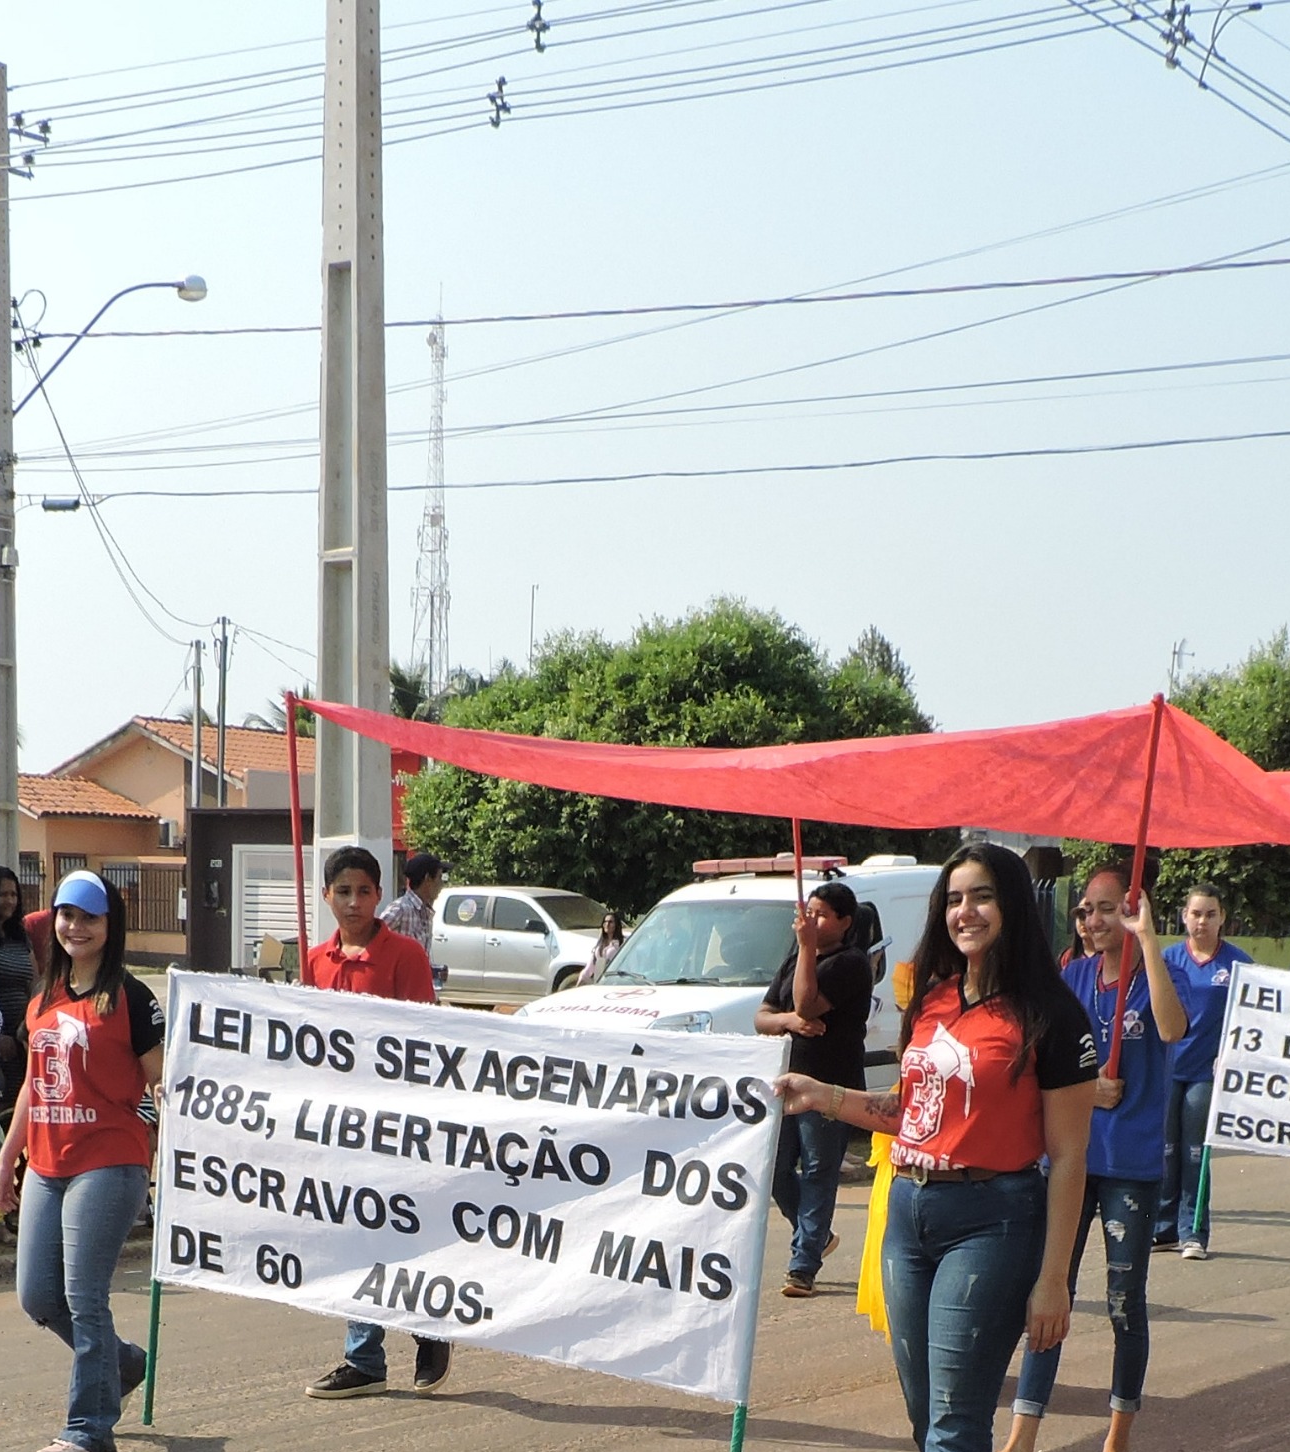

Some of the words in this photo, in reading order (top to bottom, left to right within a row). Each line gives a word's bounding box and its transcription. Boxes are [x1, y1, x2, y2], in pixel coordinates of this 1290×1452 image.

[1238, 983, 1282, 1013] LEI
[31, 1028, 73, 1102] 3
[189, 1003, 251, 1055] LEI
[266, 1018, 356, 1073] DOS
[1229, 1025, 1264, 1053] 13
[174, 1075, 277, 1140] 1885,
[294, 1098, 611, 1187] LIBERTAÇÃO
[641, 1149, 748, 1211] DOS
[173, 1149, 421, 1234] ESCRAVOS
[452, 1200, 564, 1264] COM
[589, 1230, 733, 1302] MAIS
[169, 1224, 225, 1274] DE
[255, 1243, 303, 1290] 60
[352, 1262, 494, 1325] ANOS.
